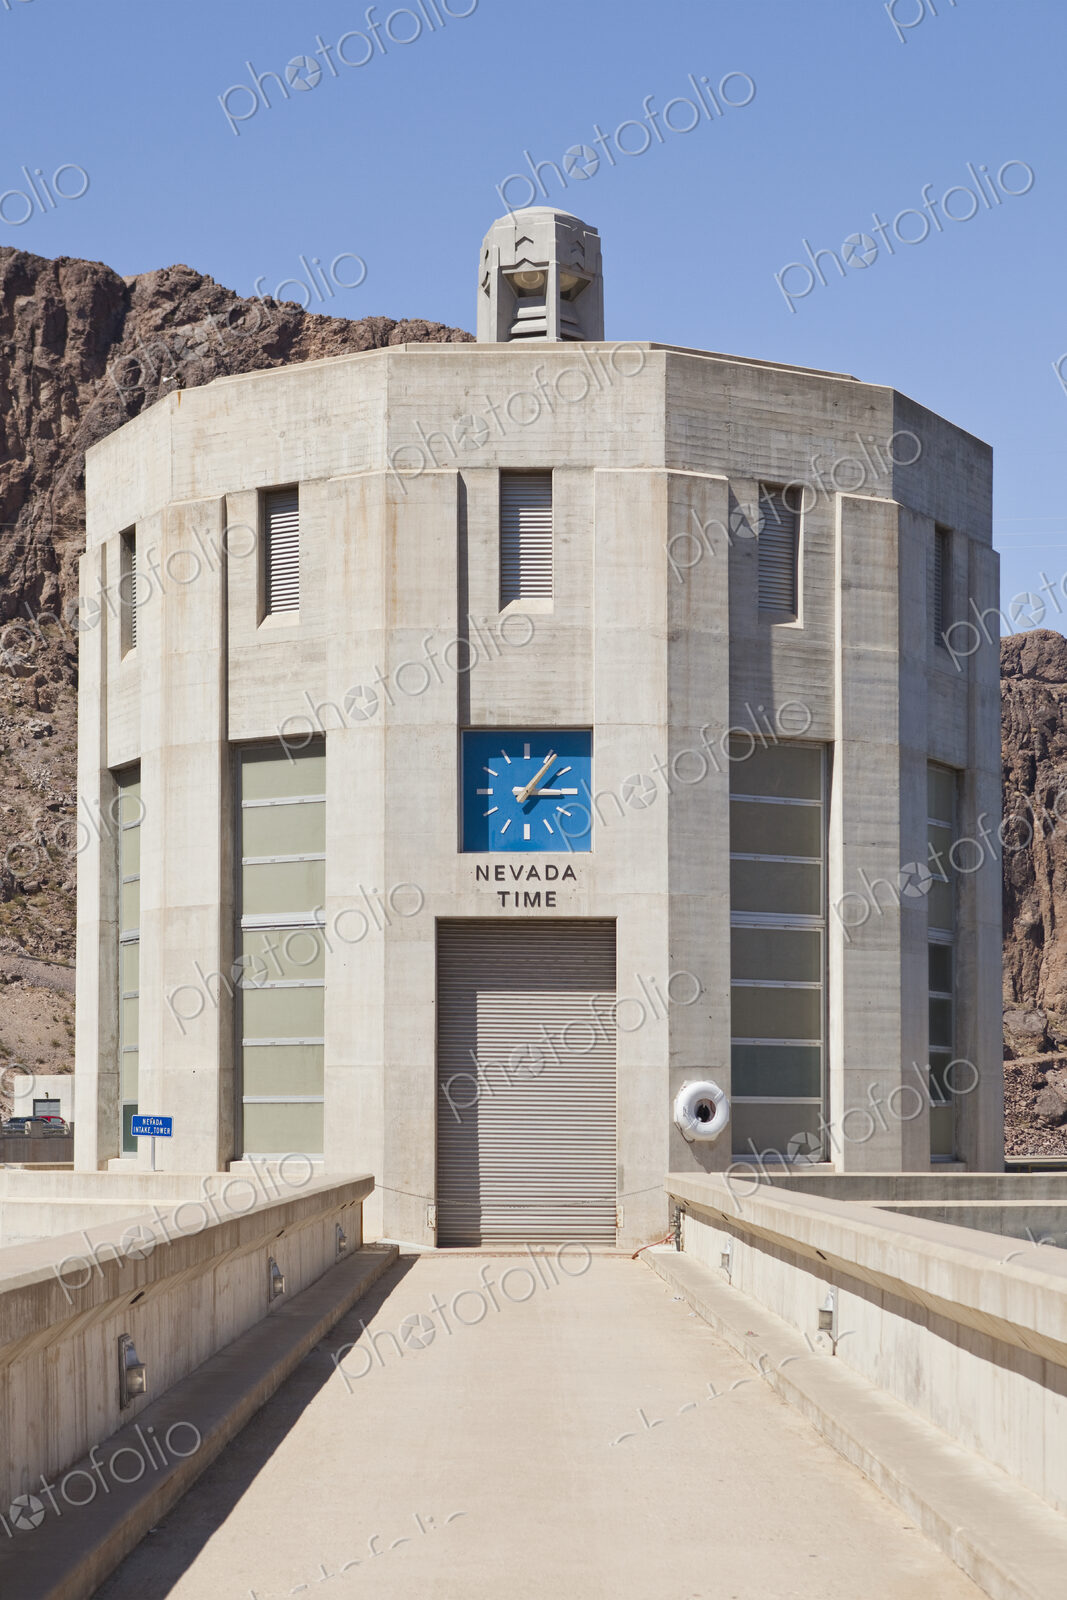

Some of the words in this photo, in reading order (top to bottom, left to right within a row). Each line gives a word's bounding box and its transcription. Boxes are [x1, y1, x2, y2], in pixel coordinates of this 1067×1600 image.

[475, 864, 577, 881] NEVADA
[497, 891, 557, 908] TIME
[142, 1118, 163, 1126] NEVADA
[133, 1126, 151, 1134] INTAKE
[153, 1127, 171, 1135] TOWER
